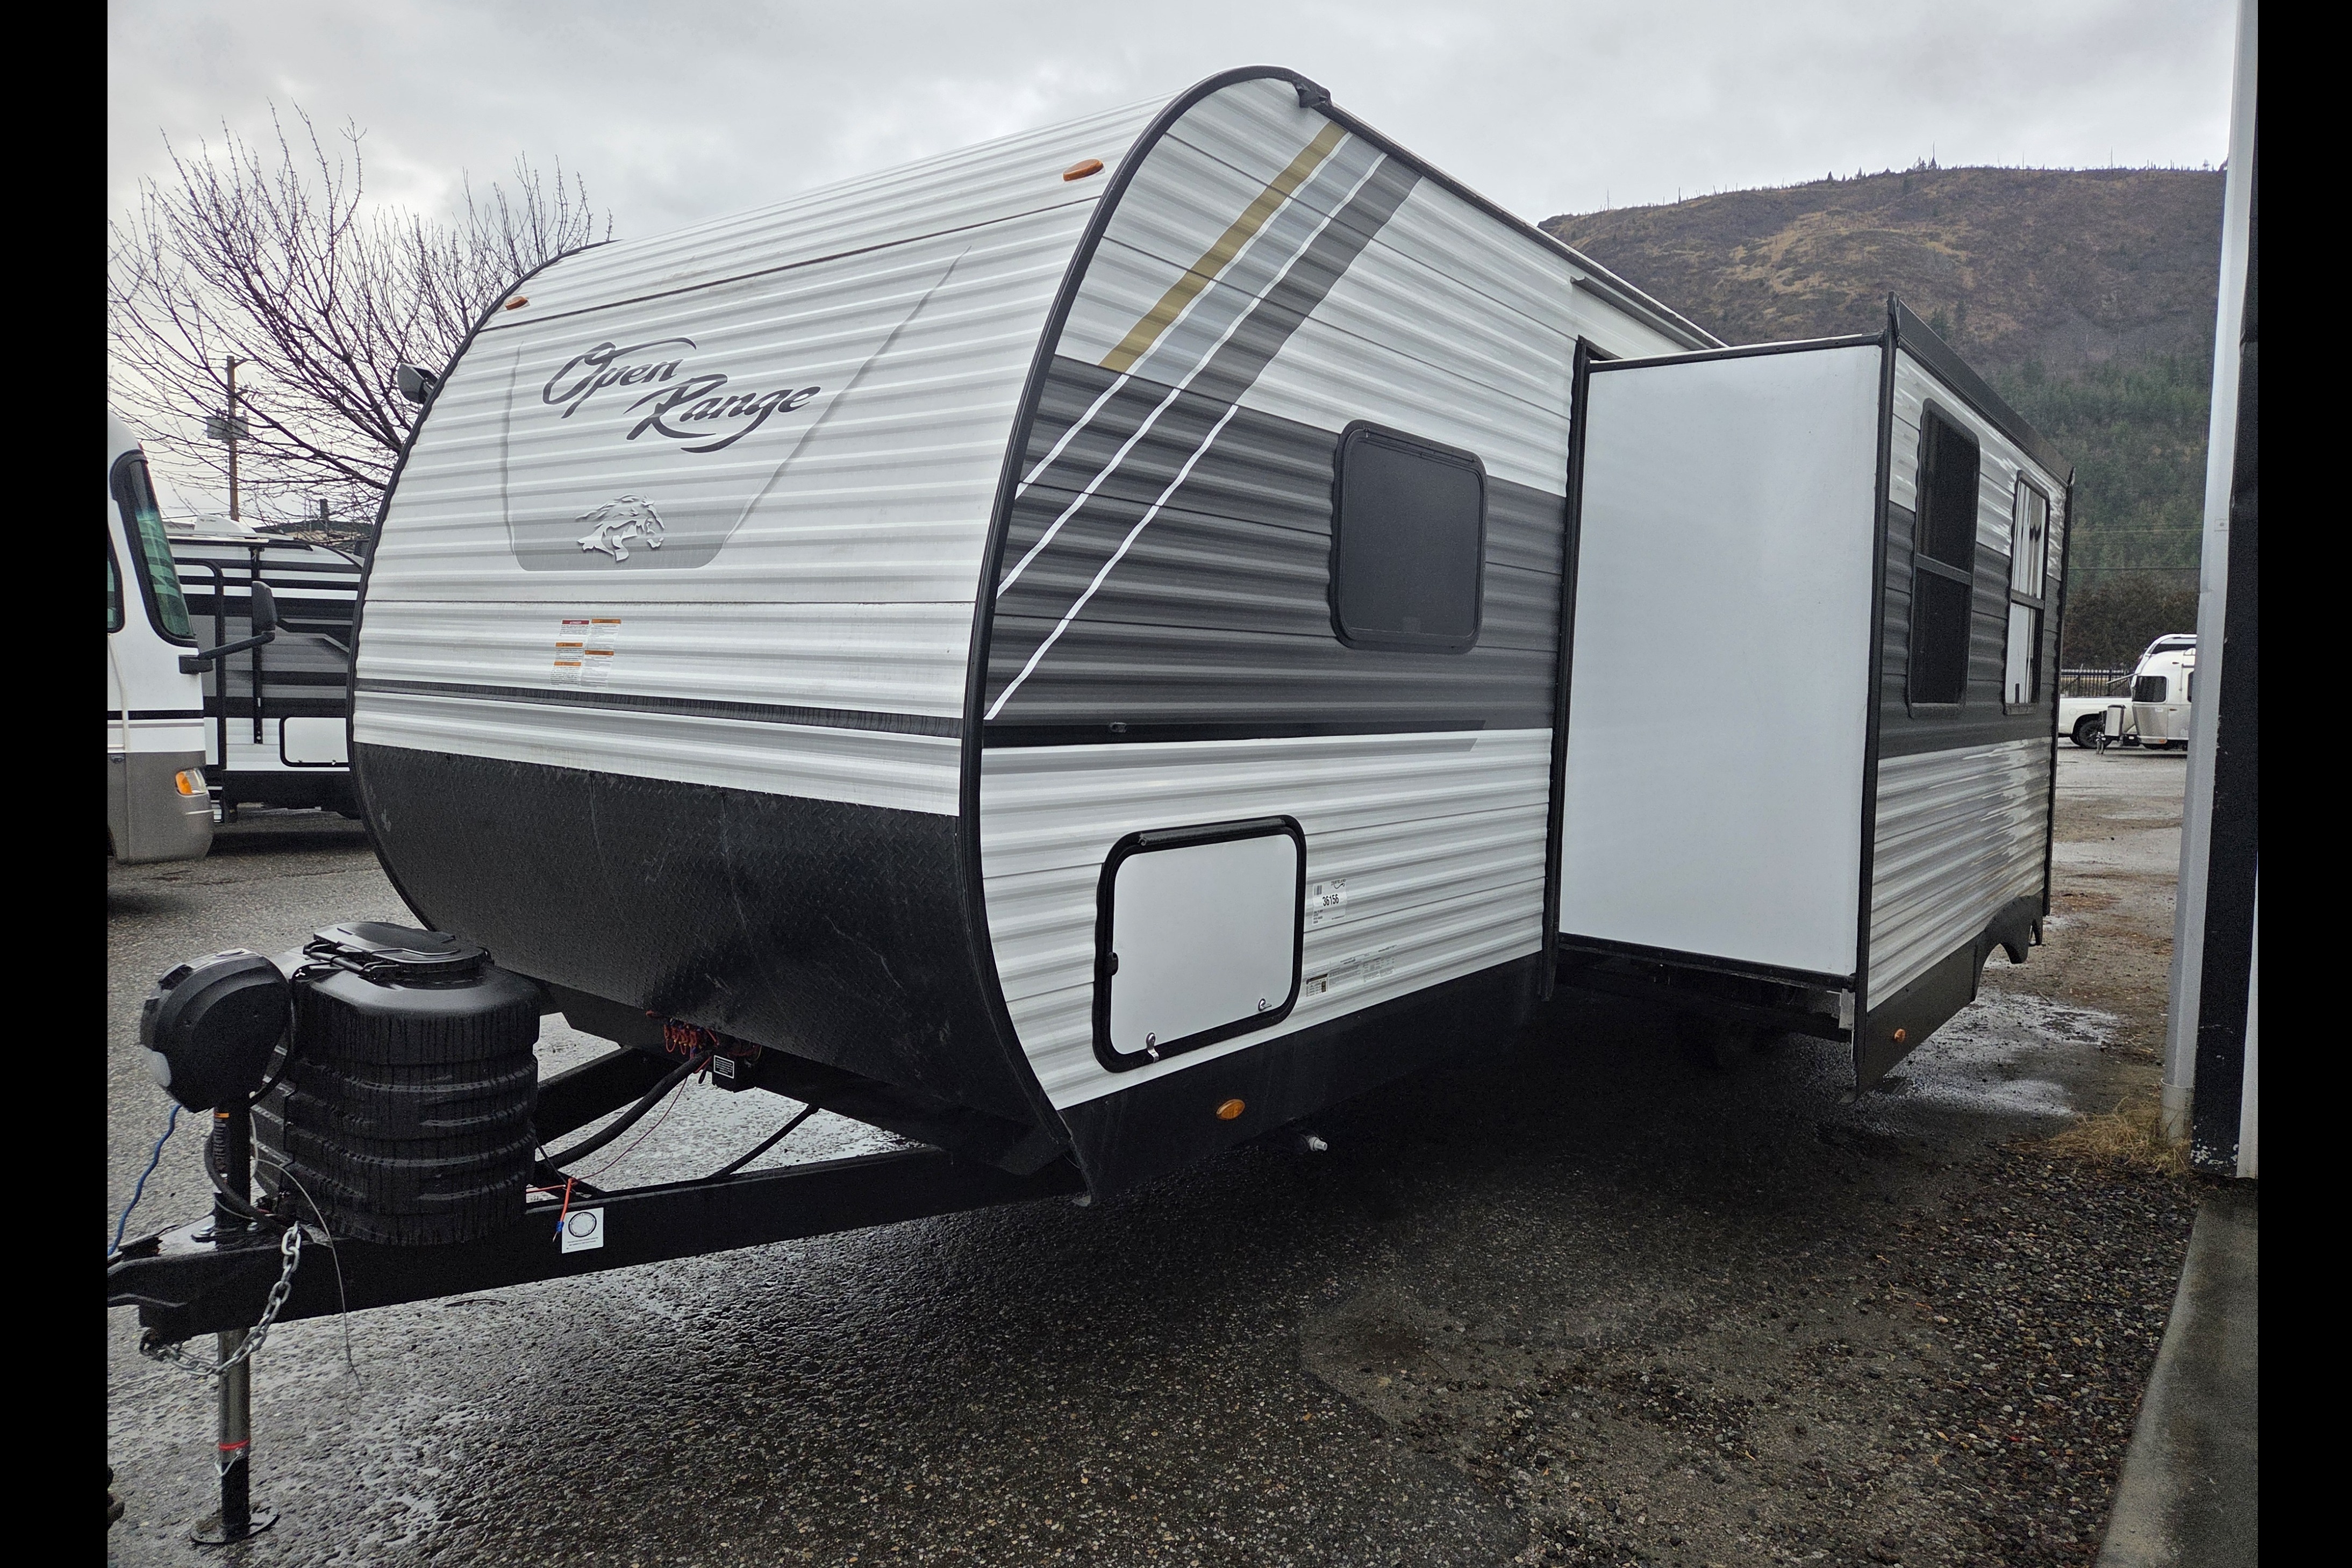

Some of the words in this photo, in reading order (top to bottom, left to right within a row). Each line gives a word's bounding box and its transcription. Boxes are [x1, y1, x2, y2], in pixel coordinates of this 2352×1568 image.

[542, 337, 696, 419] Open
[623, 374, 821, 453] Range
[1322, 893, 1339, 906] 36156
